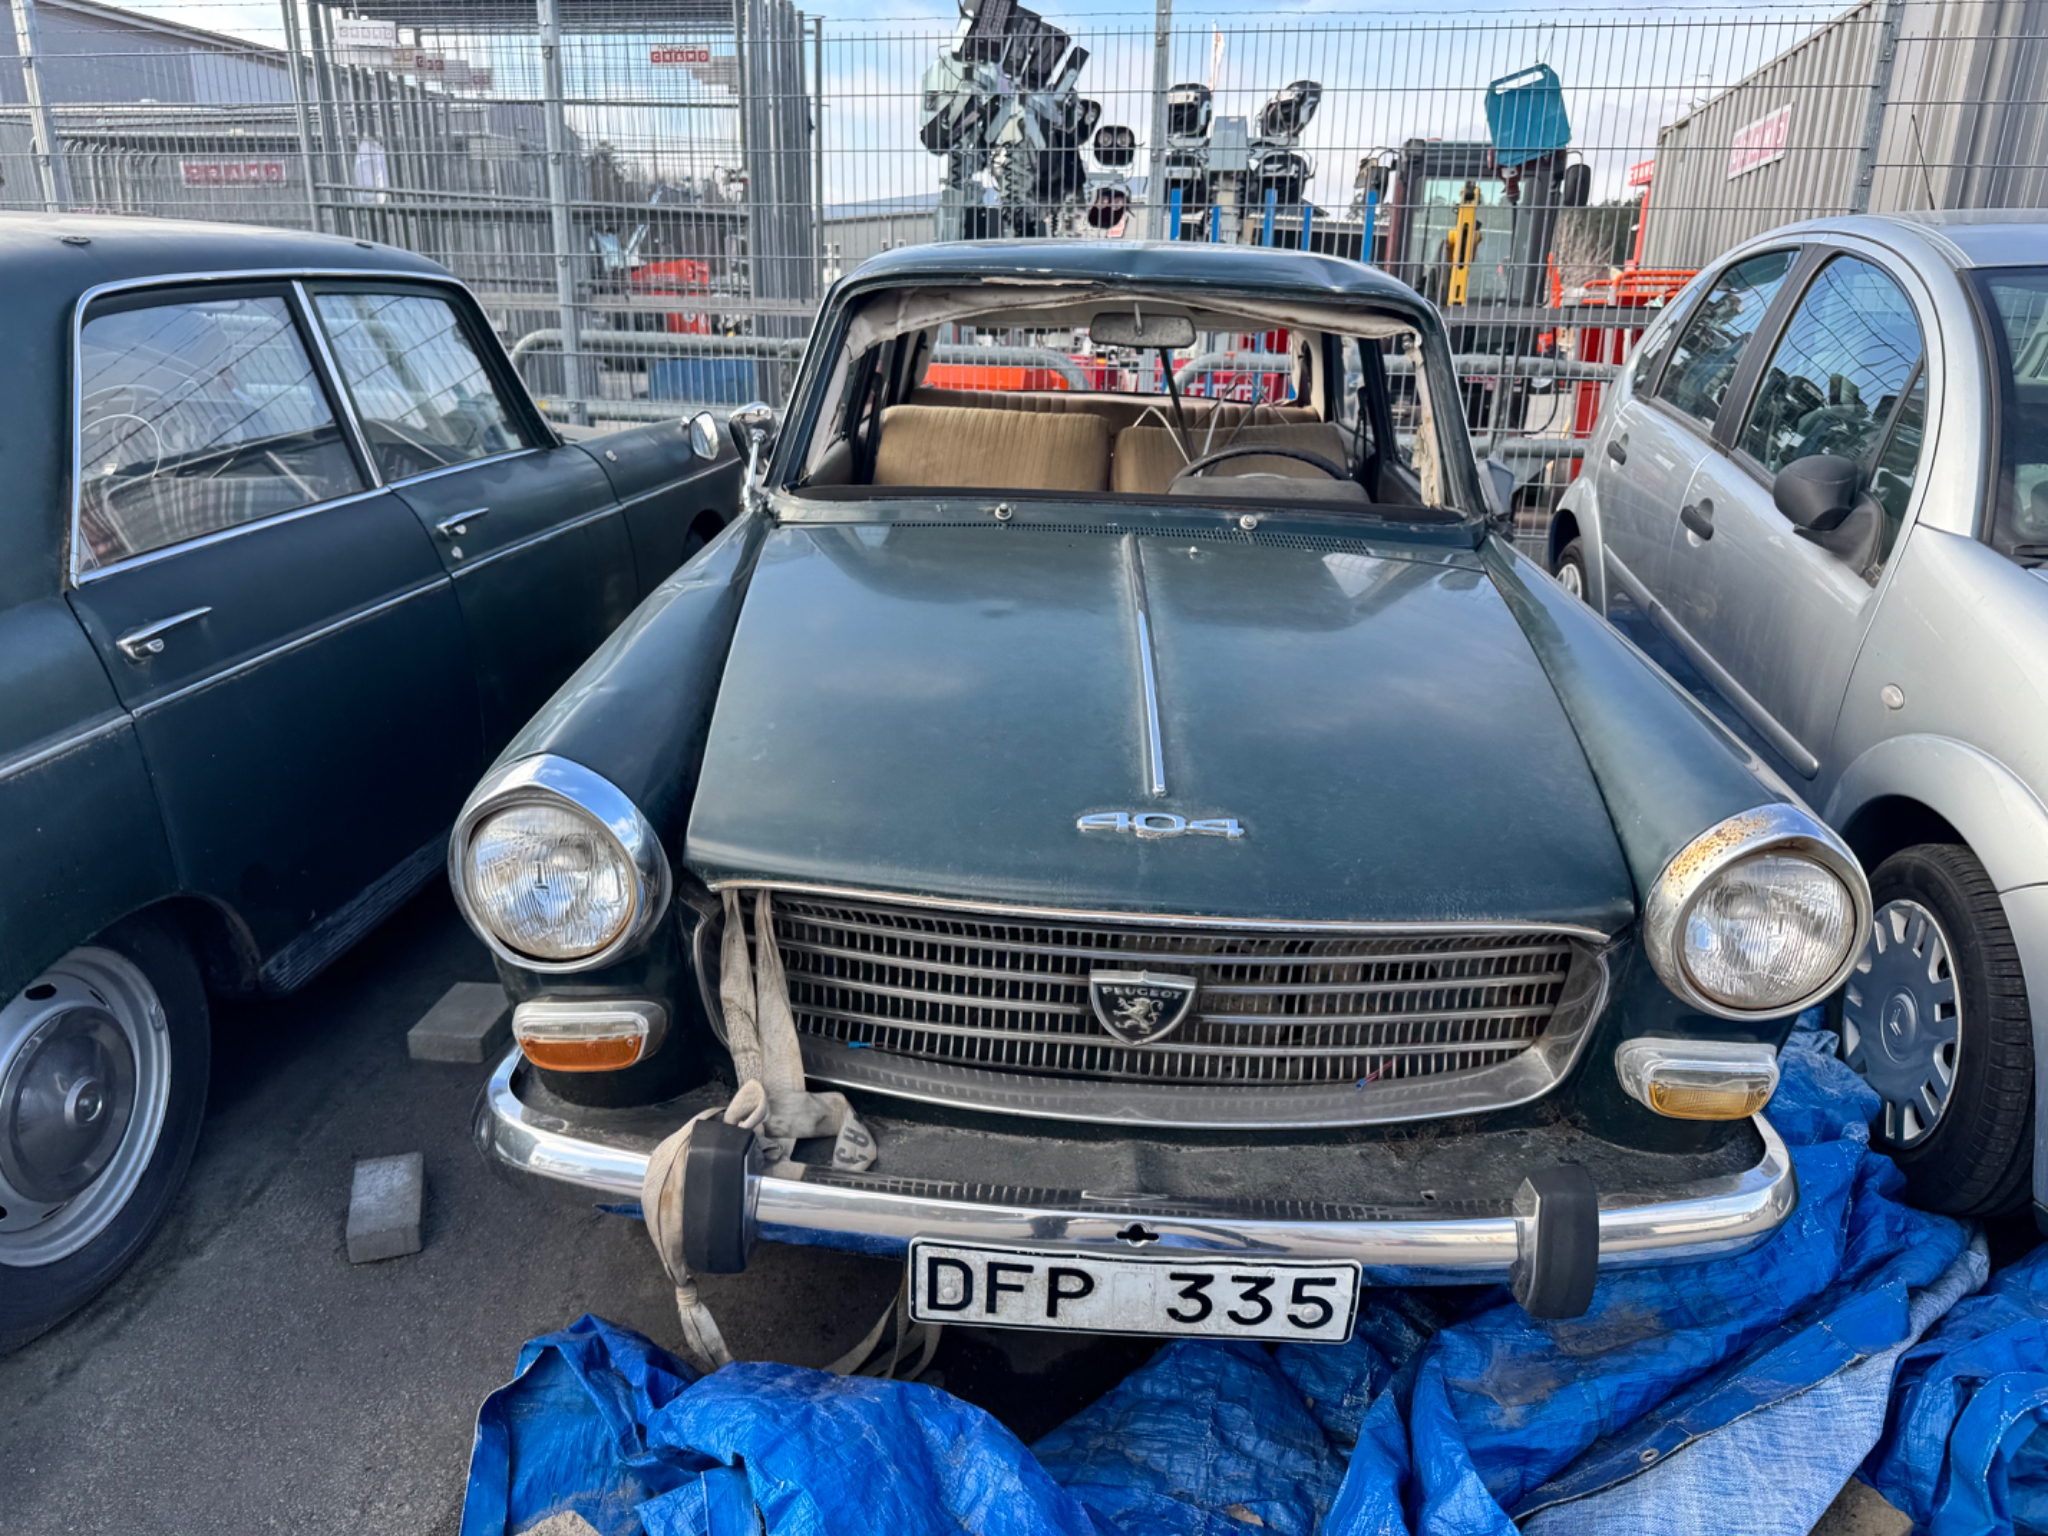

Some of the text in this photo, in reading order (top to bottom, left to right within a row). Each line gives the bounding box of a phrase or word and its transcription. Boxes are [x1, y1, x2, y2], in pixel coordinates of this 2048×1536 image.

[651, 50, 709, 62] CRAMO
[1077, 812, 1245, 838] 404
[1102, 985, 1182, 999] PEUGEOT
[927, 1256, 1338, 1329] DFP 335
